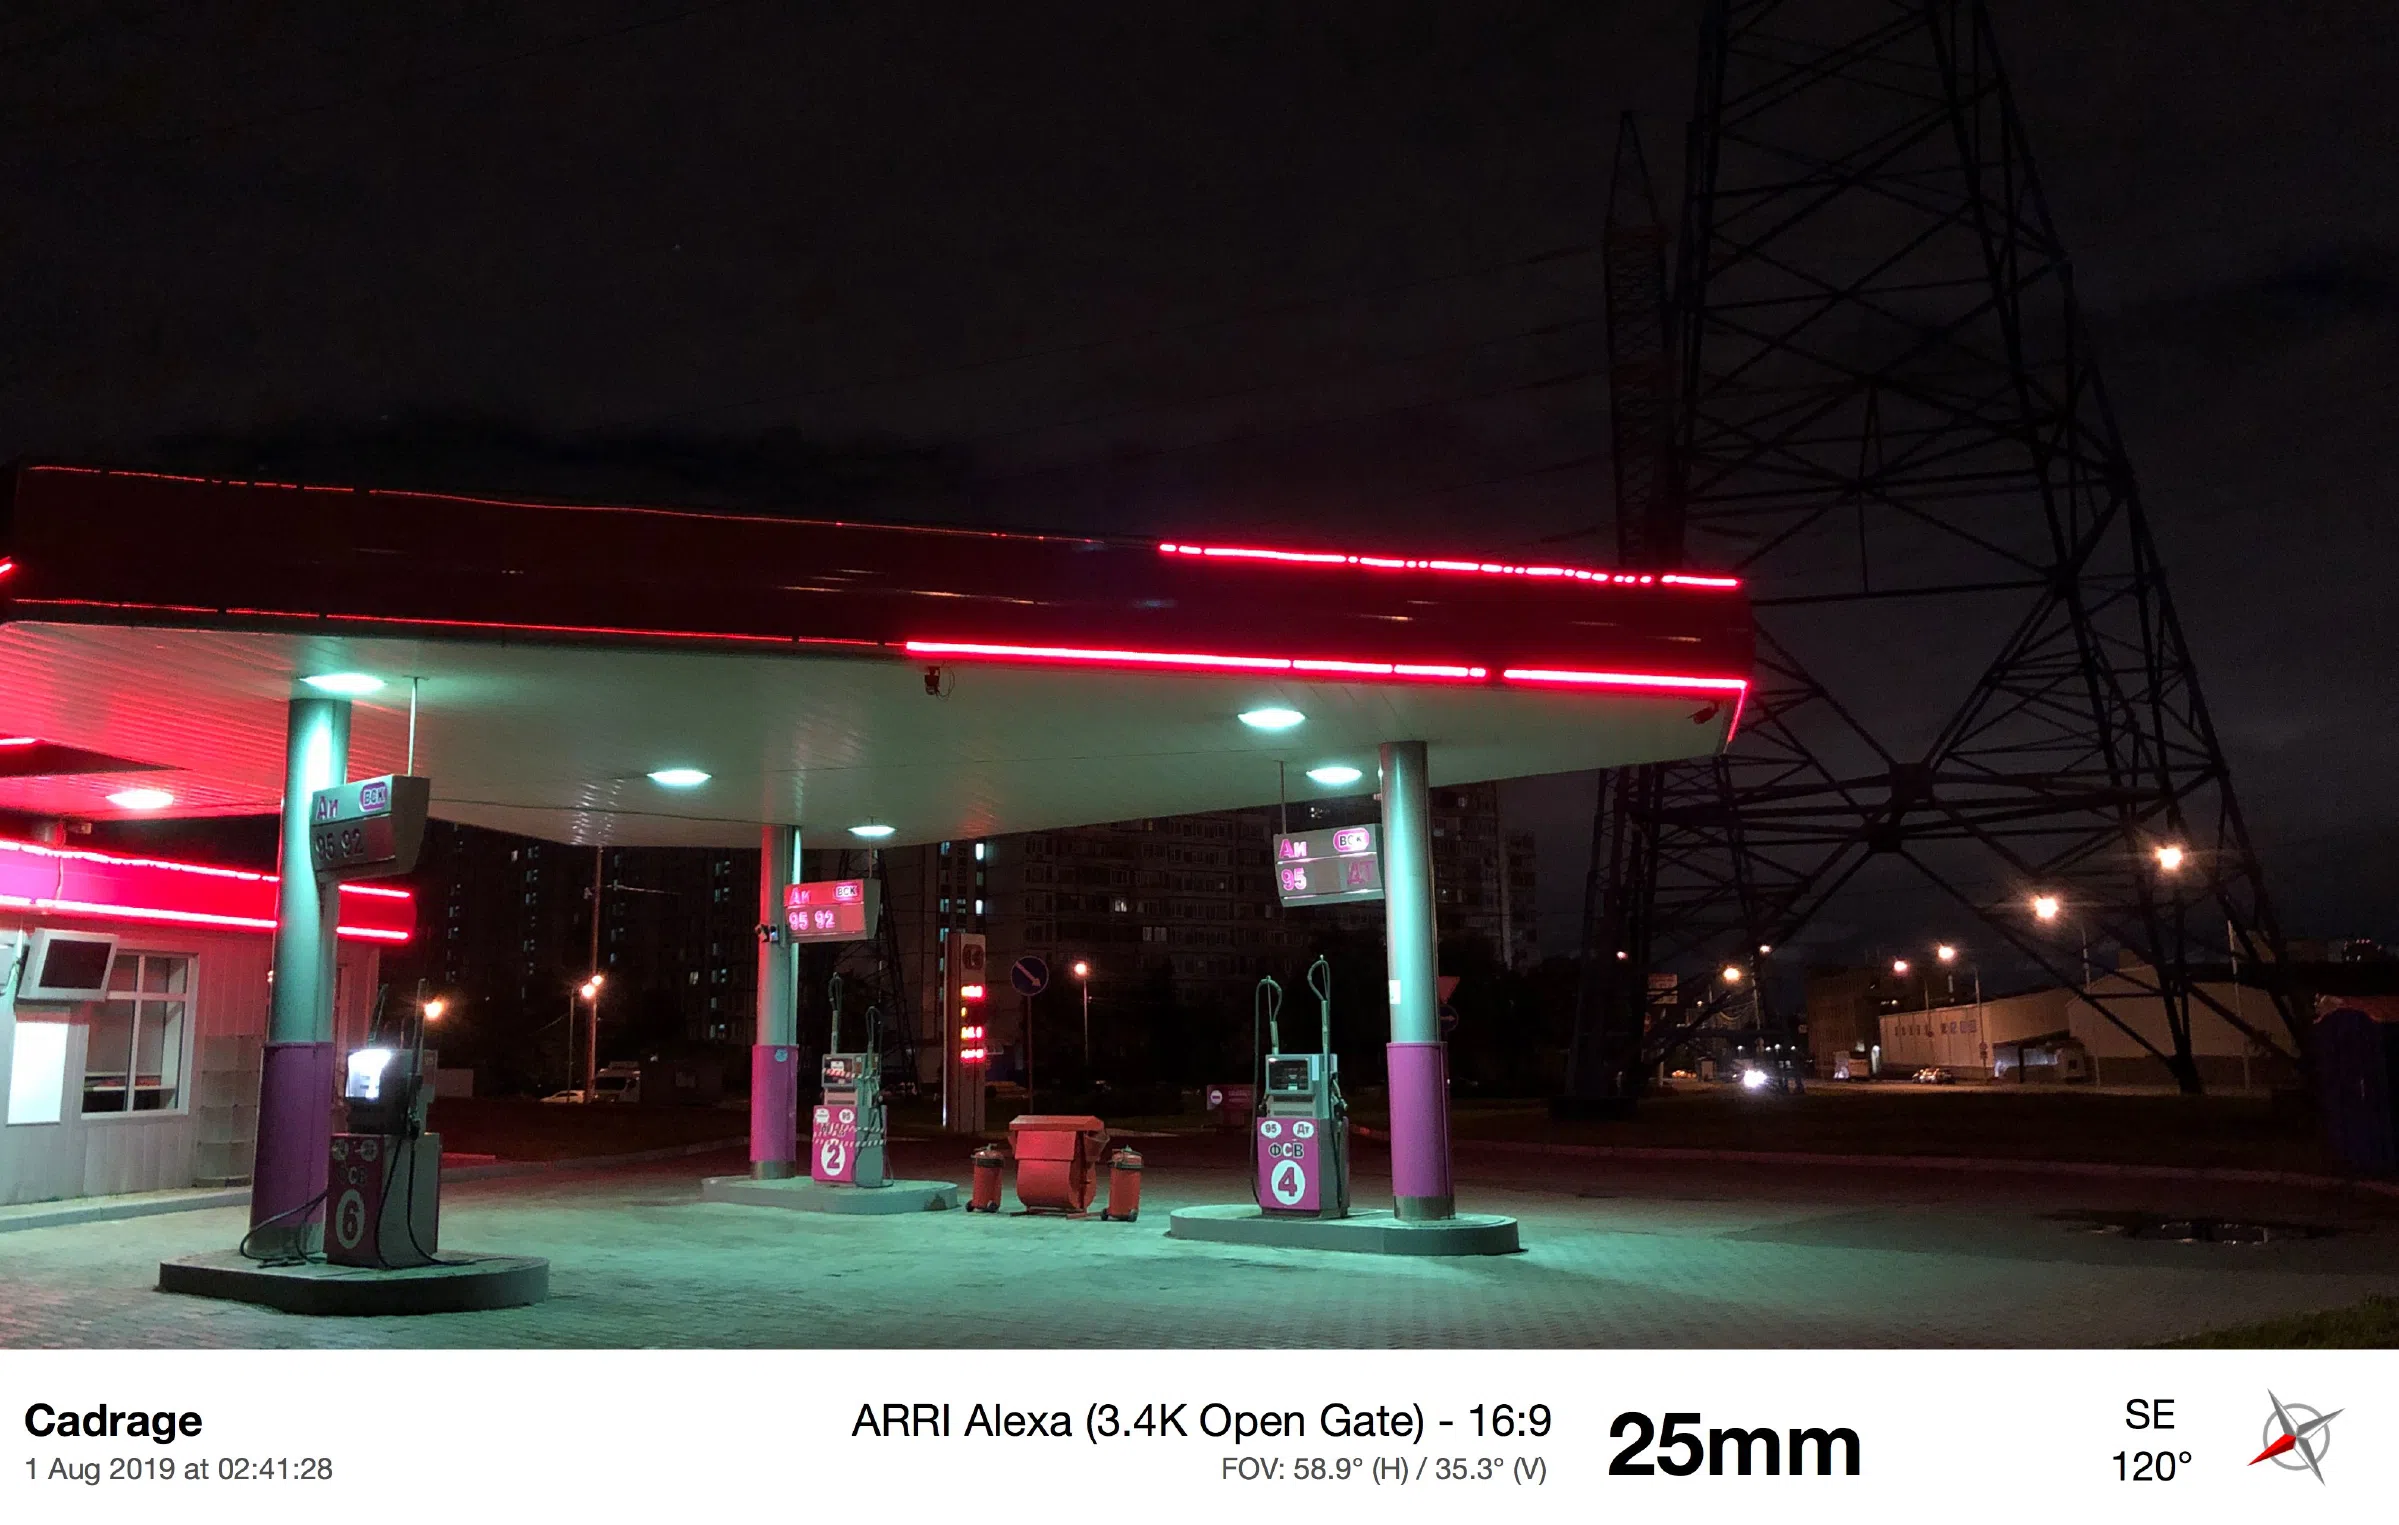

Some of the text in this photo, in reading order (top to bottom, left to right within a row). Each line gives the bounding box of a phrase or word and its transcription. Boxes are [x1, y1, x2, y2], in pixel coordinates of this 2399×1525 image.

[315, 828, 363, 860] 95 92
[1281, 867, 1307, 891] 95
[836, 885, 858, 898] ВСК
[788, 909, 836, 931] 95 92
[1264, 1123, 1278, 1134] 95
[826, 1142, 841, 1170] 2
[1268, 1142, 1304, 1159] ФСВ
[1277, 1166, 1298, 1197] 4
[342, 1199, 359, 1241] 6
